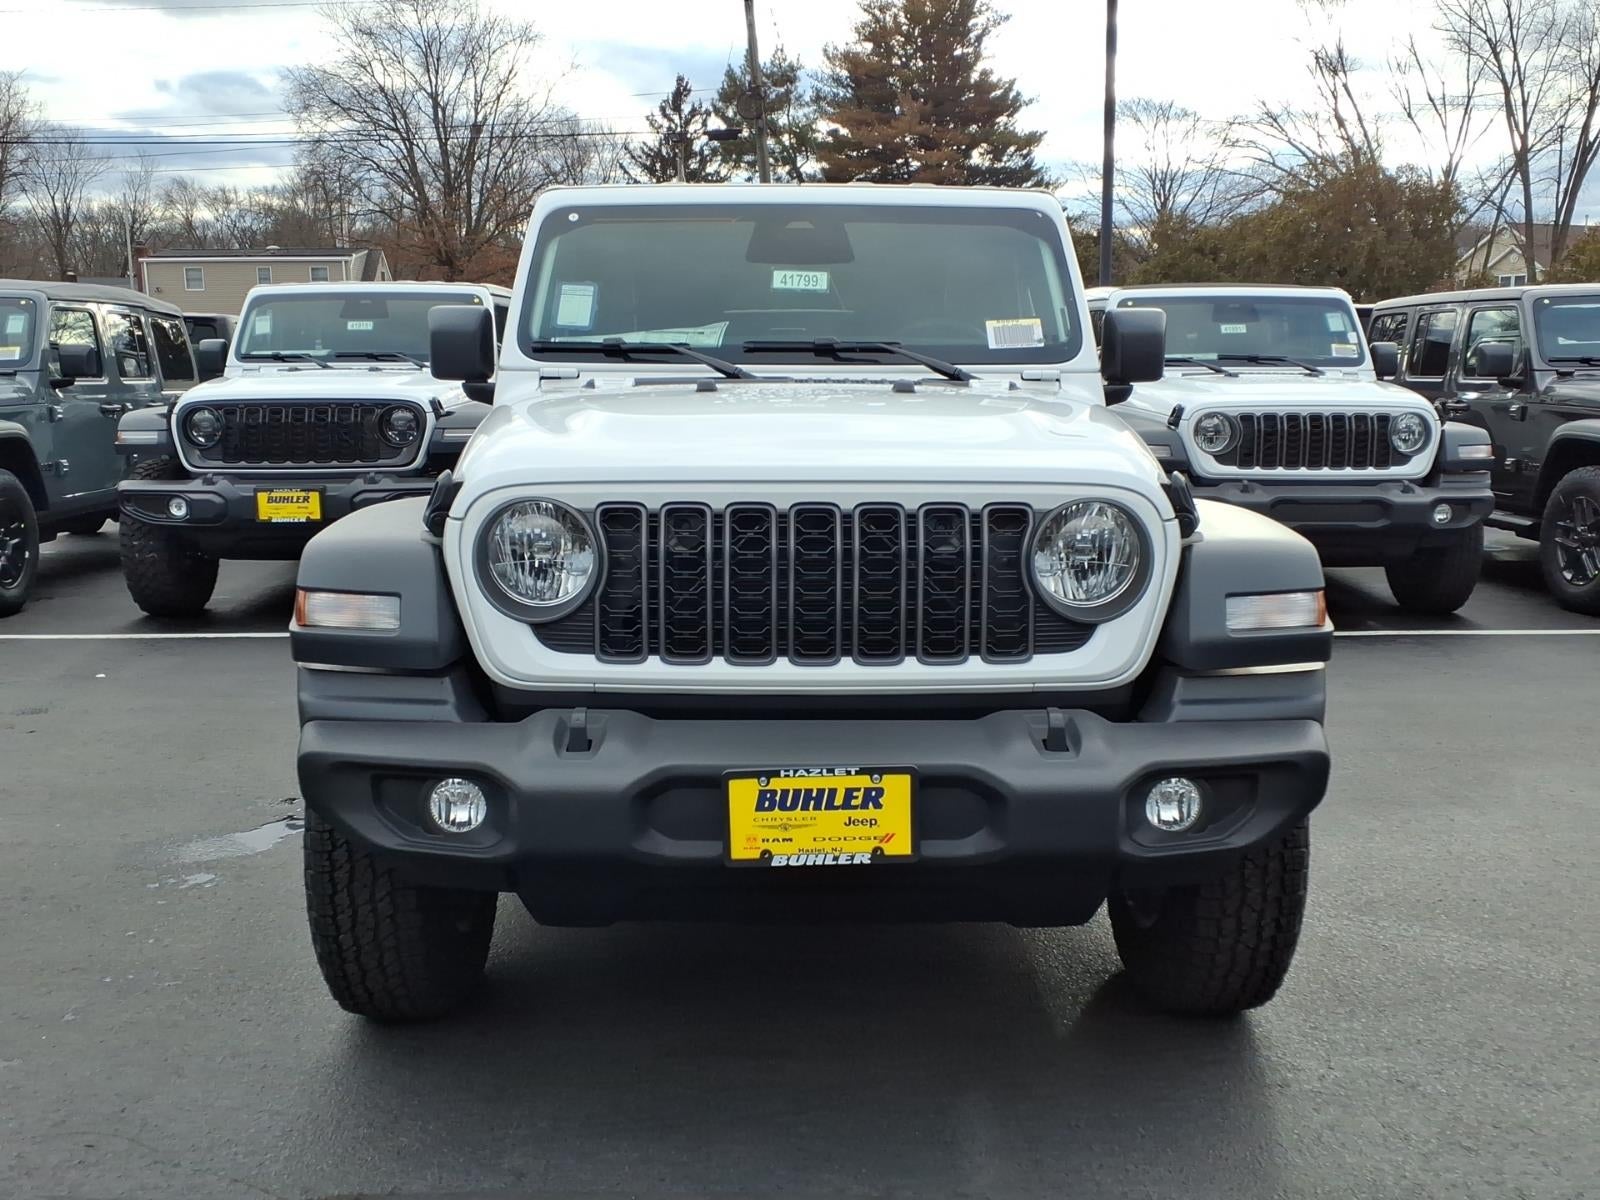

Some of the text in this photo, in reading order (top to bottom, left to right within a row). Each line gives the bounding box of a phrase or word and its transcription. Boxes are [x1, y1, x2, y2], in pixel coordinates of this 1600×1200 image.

[780, 273, 819, 288] 41799
[266, 495, 310, 504] BUHLER
[780, 767, 860, 778] HAZLET
[755, 786, 885, 813] BUHLER
[843, 816, 878, 828] Jeep
[771, 853, 871, 867] BUHLER
